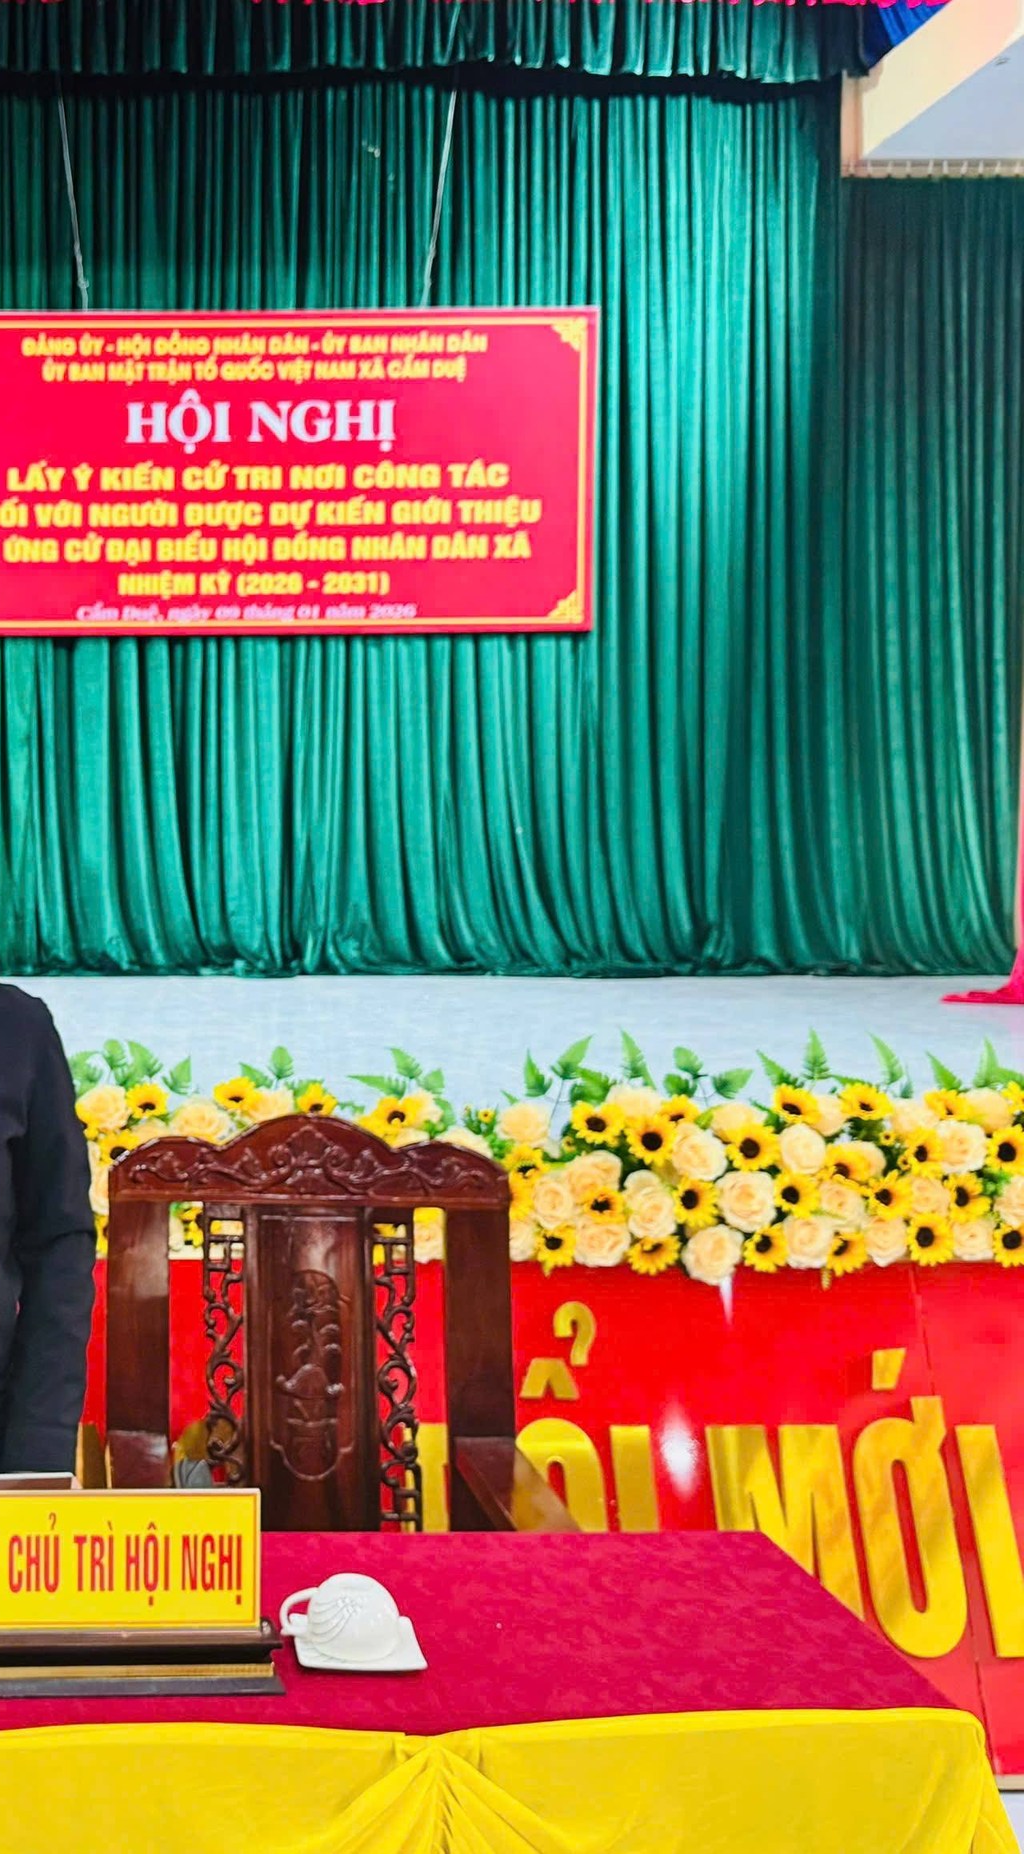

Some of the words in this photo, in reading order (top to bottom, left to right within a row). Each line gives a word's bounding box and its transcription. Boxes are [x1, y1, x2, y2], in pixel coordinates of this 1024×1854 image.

[116, 333, 151, 360] HỘI
[213, 332, 266, 355] NHÂN
[268, 332, 309, 355] DÂN
[349, 335, 388, 354] BAN
[390, 331, 444, 354] NHÂN
[446, 330, 488, 353] DÂN
[68, 362, 106, 382] BAN
[221, 355, 275, 381] QUỐC
[276, 357, 313, 384] VIỆT
[314, 360, 357, 380] NAM
[358, 356, 385, 380] XÃ
[432, 355, 467, 383] DUỆ
[125, 388, 232, 454] HỘI
[247, 399, 396, 452] NGHỊ
[6, 460, 66, 492] LẤY
[72, 462, 94, 492] Ý
[100, 460, 175, 491] KIẾN
[181, 459, 229, 491] CỬ
[232, 466, 282, 490] TRI
[289, 463, 346, 490] NƠI
[353, 460, 441, 489] CÔNG
[447, 459, 509, 488] TÁC
[34, 499, 83, 527] VỚI
[88, 498, 178, 527] NGƯỜI
[184, 500, 263, 531] ĐƯỢC
[269, 499, 314, 531] DỰ
[316, 495, 386, 526] KIẾN
[391, 495, 453, 525] GIỚI
[457, 495, 542, 528] THIỆU
[3, 534, 59, 563] ỨNG
[63, 531, 104, 563] CỬ
[105, 537, 152, 567] ĐẠI
[222, 533, 268, 566] HỘI
[351, 532, 427, 560] NHÂN
[431, 531, 489, 560] DÂN
[493, 530, 532, 559] XÃ
[118, 570, 195, 600] NHIỆM
[236, 571, 303, 597] (2026
[322, 570, 390, 596] 2031)
[167, 604, 212, 622] ngày
[8, 1512, 61, 1593] CHỦ
[73, 1521, 115, 1592] TRÌ
[125, 1522, 171, 1606] HỘI
[181, 1534, 243, 1605] NGHỊ
